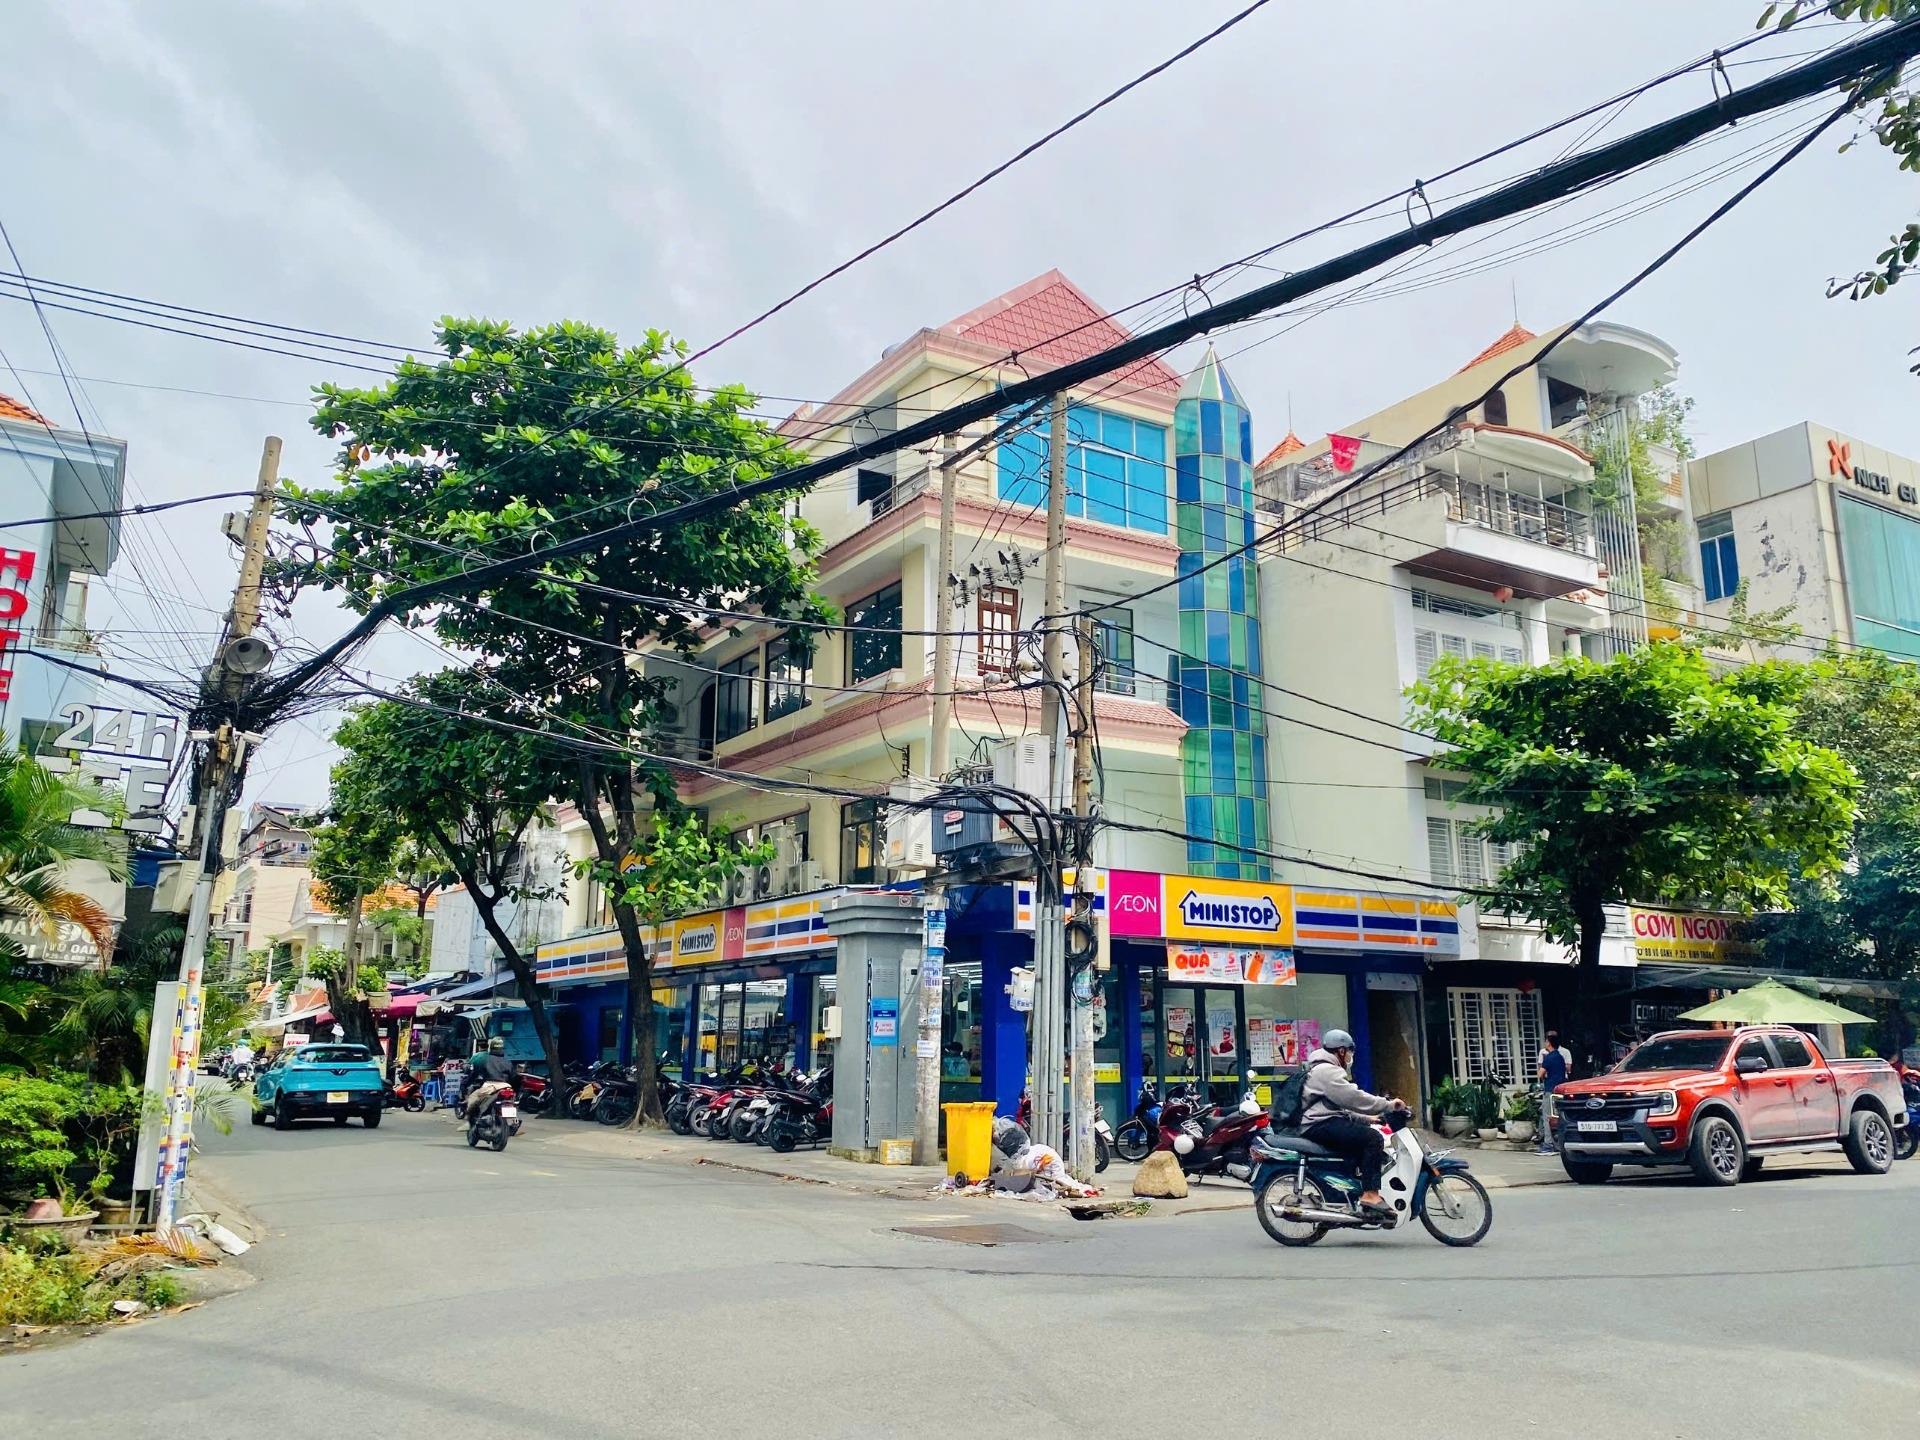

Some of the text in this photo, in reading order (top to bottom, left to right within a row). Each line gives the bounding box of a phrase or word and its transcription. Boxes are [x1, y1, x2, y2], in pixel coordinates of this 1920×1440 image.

[53, 702, 177, 760] 24h
[1190, 902, 1274, 925] MINISTOP
[681, 933, 714, 951] MINISTOP
